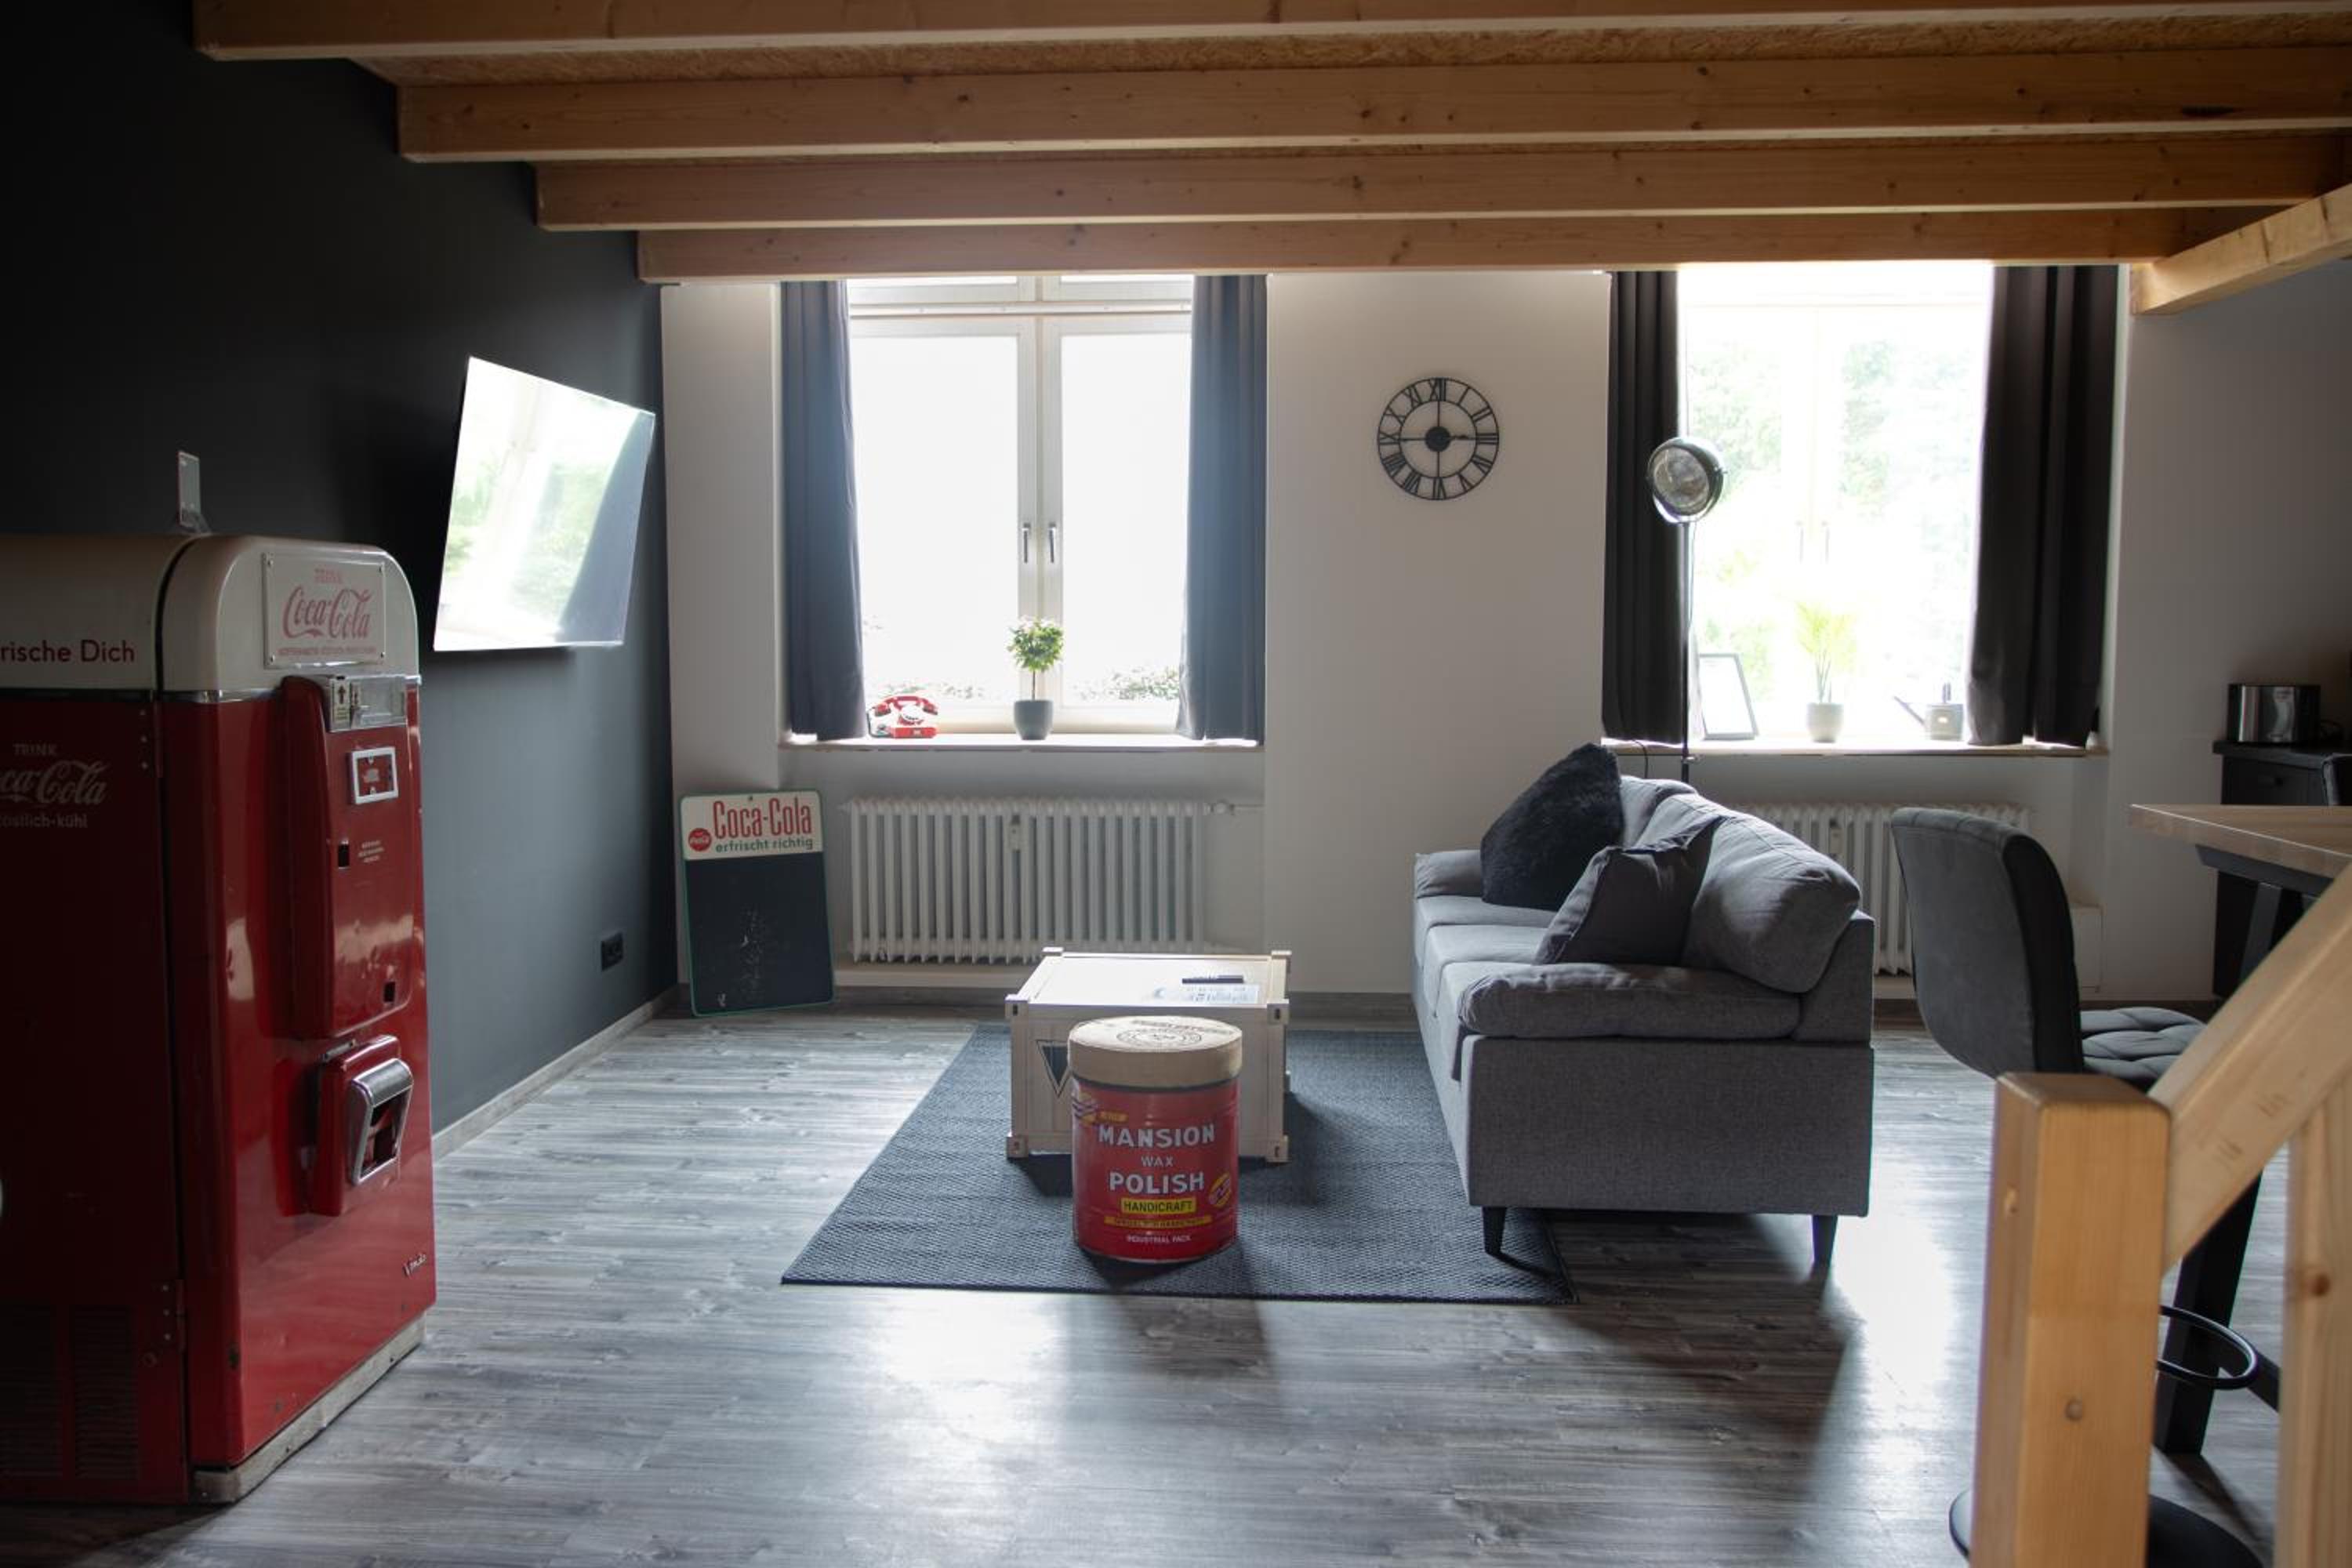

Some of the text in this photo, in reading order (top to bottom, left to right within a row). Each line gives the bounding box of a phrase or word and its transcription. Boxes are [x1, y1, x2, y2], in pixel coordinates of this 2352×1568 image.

[283, 586, 372, 639] Coca-Cola
[0, 639, 135, 662] rische Dich
[13, 742, 58, 757] TRINK
[713, 796, 812, 840] Coca-Cola
[715, 838, 770, 853] erfrischt
[772, 837, 813, 851] richtig
[1098, 1123, 1215, 1148] MANSION
[1141, 1156, 1174, 1167] WAX
[1109, 1171, 1204, 1194] POLISH
[1123, 1200, 1193, 1213] HANDICRAFT
